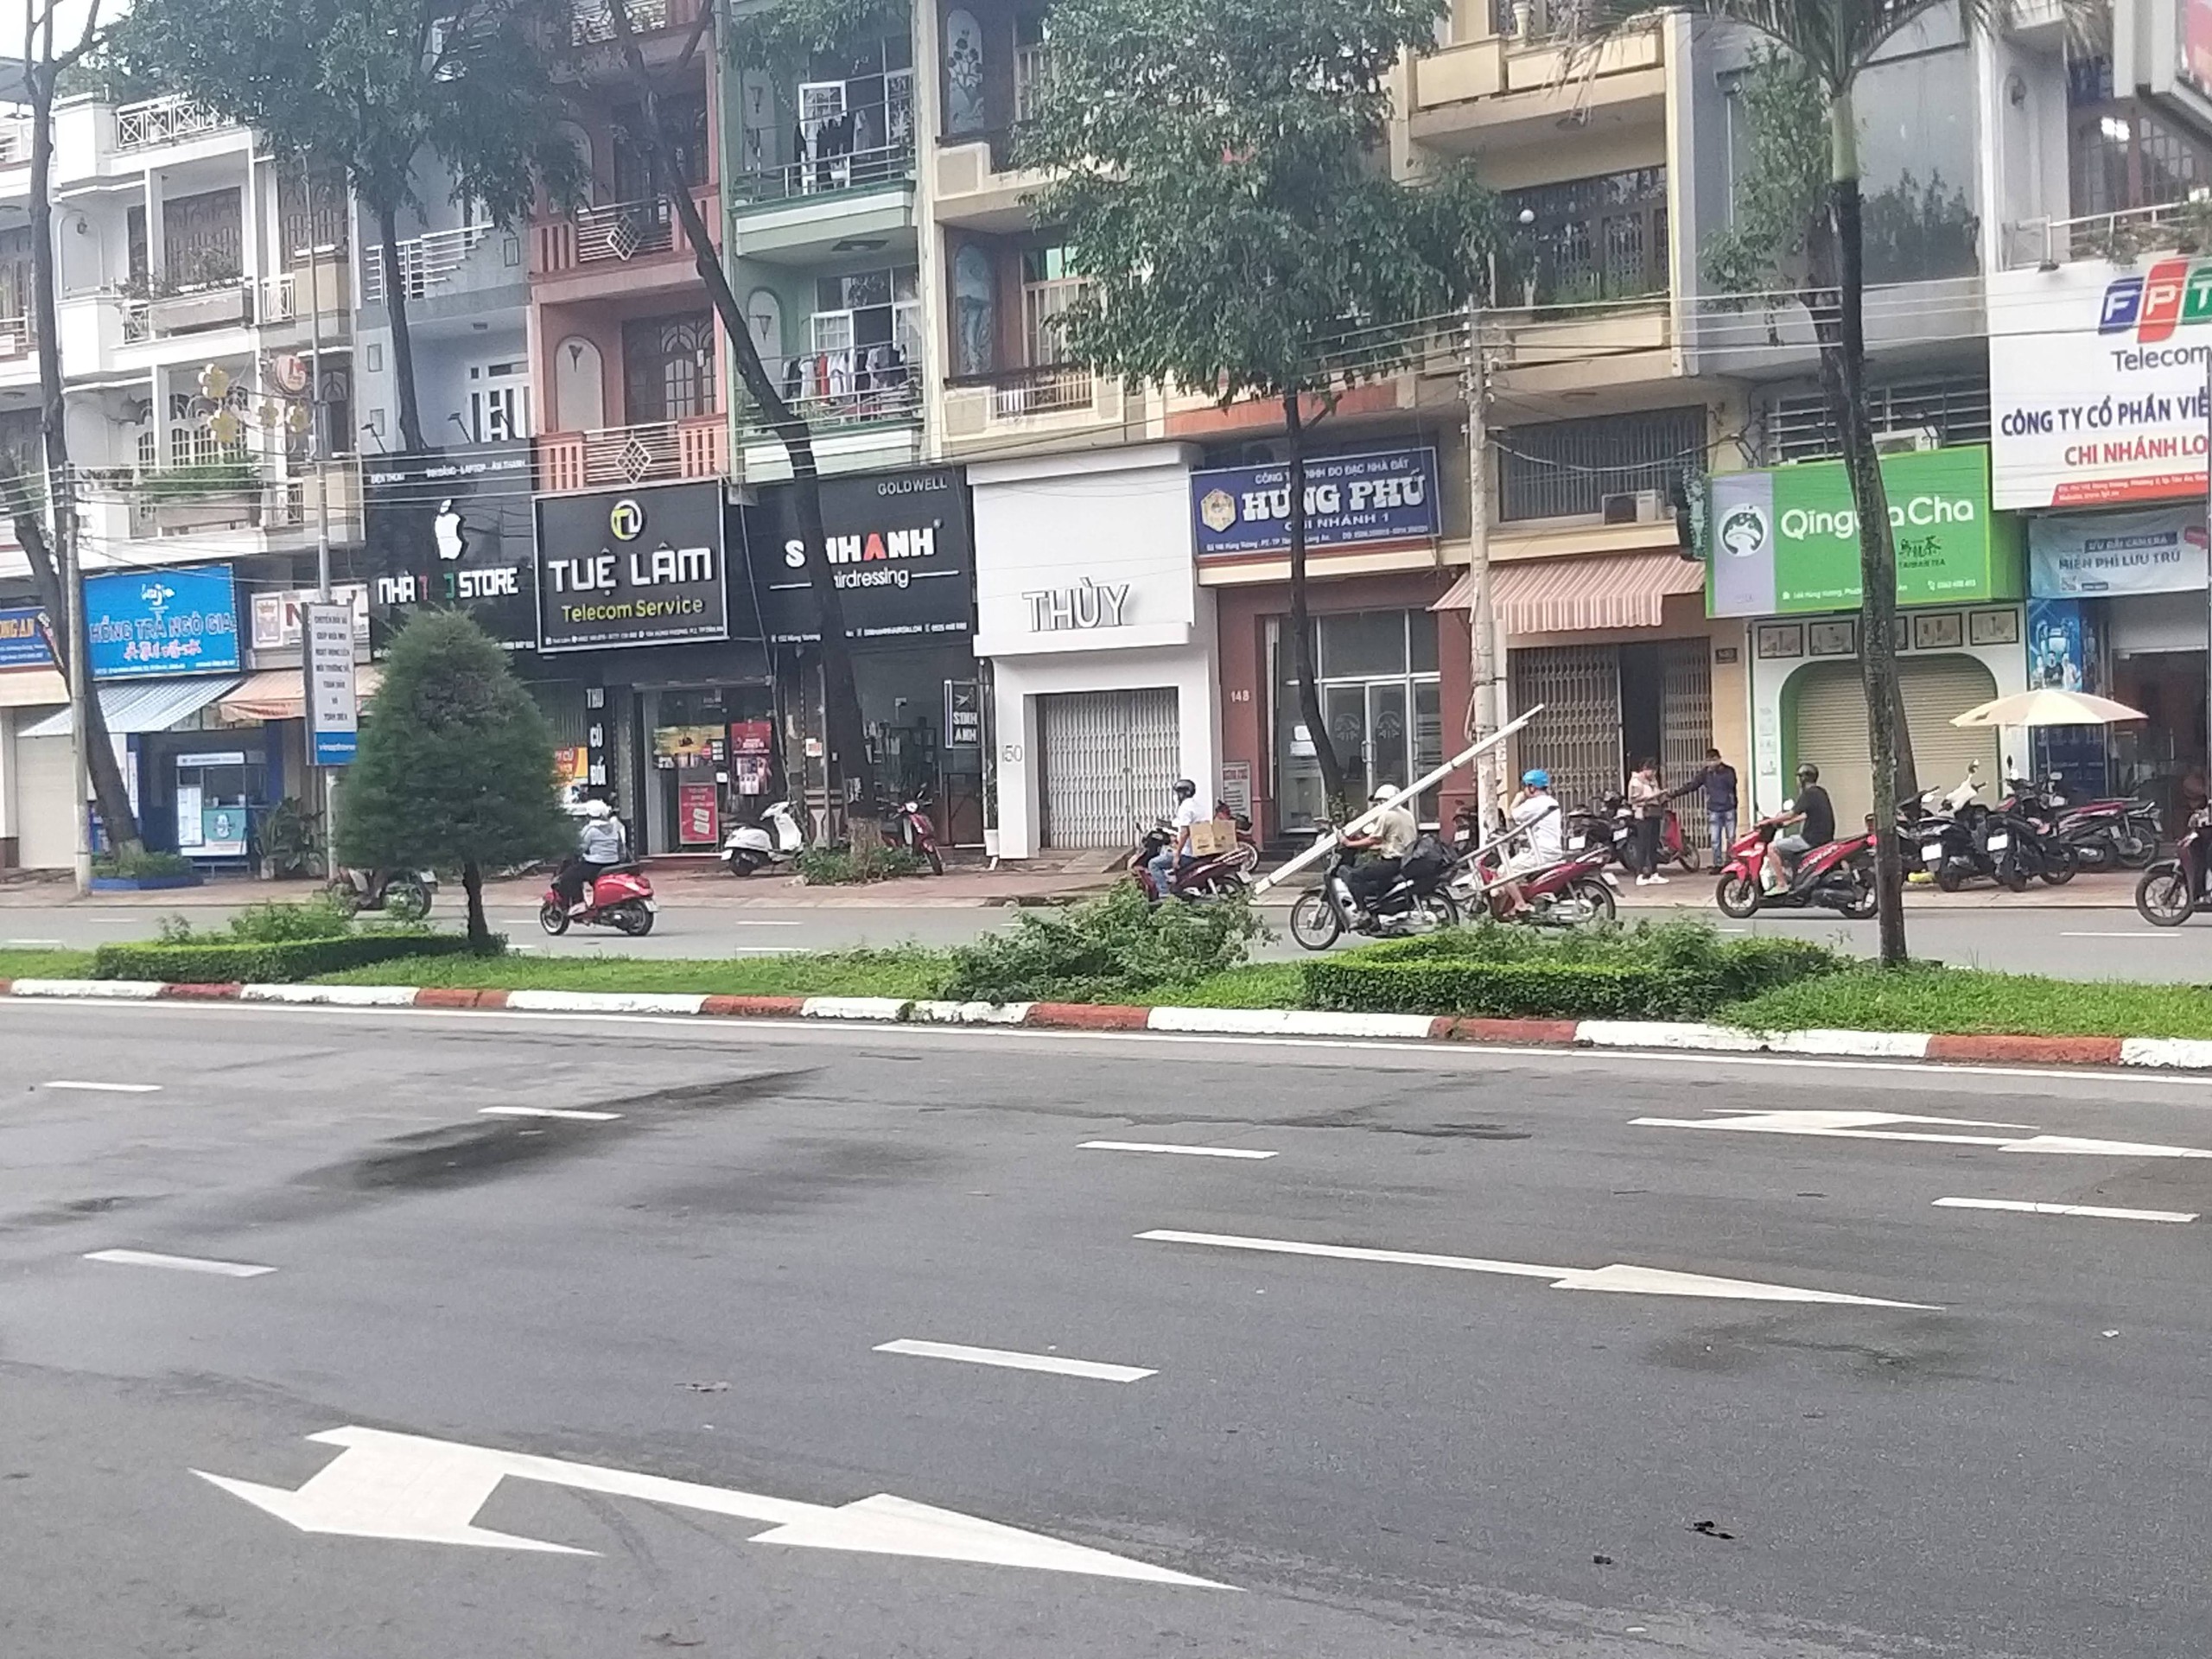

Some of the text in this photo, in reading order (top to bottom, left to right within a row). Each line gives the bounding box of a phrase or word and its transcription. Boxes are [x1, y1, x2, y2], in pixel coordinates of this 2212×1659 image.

[2111, 345, 2210, 372] Telecom
[2001, 408, 2053, 435] CÔNG
[2058, 407, 2083, 430] TY
[2064, 446, 2098, 466] CHI
[2104, 435, 2177, 465] NHÁNH
[877, 478, 948, 496] GOLDWELL
[1255, 472, 1283, 484] CÔNG
[1348, 468, 1426, 511] PHÚ
[1318, 513, 1376, 528] NHÁNH
[1382, 512, 1389, 522] 1
[549, 541, 712, 596] TUỆ LÂM
[459, 567, 519, 598] STORE
[562, 594, 704, 623] Telecom Service
[1021, 576, 1131, 632] THÙY
[89, 615, 131, 642] HỒNG
[1231, 690, 1250, 702] 148
[955, 728, 977, 742] ANH
